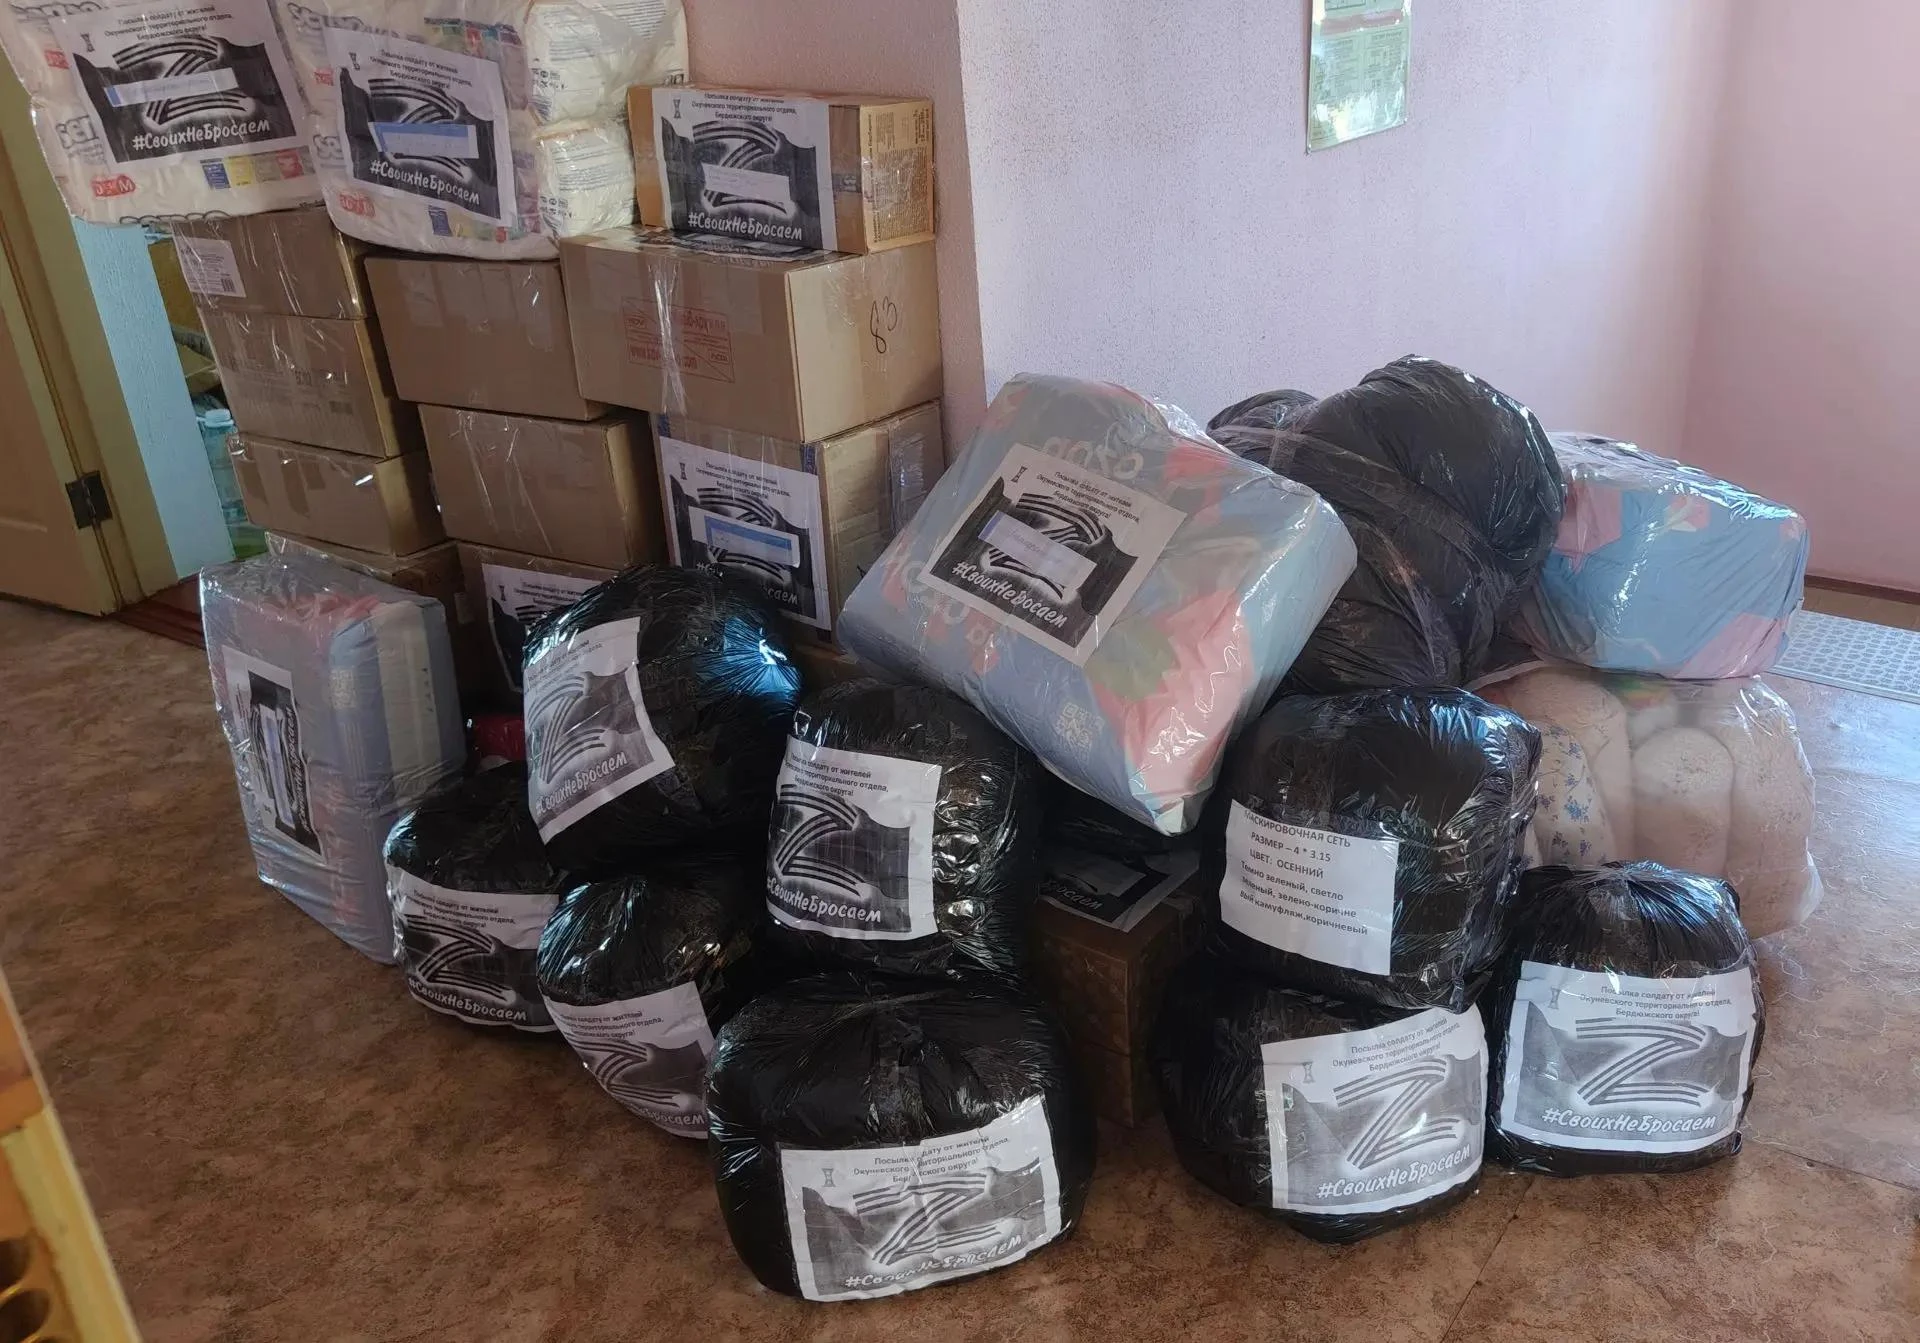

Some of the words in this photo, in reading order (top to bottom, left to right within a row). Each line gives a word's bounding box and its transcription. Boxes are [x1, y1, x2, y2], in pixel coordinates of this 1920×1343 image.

[132, 119, 270, 151] #СвоихНеБросаем
[369, 160, 480, 205] #СвоихНеБросаем
[688, 212, 802, 240] #СвоихНеБросаем
[840, 768, 871, 778] жителей
[860, 782, 889, 793] отдела,
[1251, 832, 1284, 850] РАЗМЕР
[1309, 850, 1331, 862] 3.15
[1326, 834, 1351, 848] СЕТЬ
[1249, 849, 1273, 865] ЦВЕТ:
[1277, 859, 1324, 879] ОСЕННИЙ
[1241, 860, 1264, 879] Темно
[1266, 872, 1308, 894] зеленый,
[1310, 887, 1344, 901] светло
[409, 977, 527, 1021] #СвоихНеБросаем
[1641, 990, 1675, 1001] солдату
[1616, 1009, 1673, 1020] Бердюжского
[1351, 1041, 1386, 1054] Посылка
[1386, 1033, 1416, 1047] солдату
[1417, 1030, 1424, 1038] от
[1332, 1053, 1384, 1068] Окуневского
[1369, 1053, 1419, 1072] Бердюжского
[1541, 1108, 1717, 1136] #СвоихНеБросаем
[1317, 1144, 1471, 1199] #СвоихНеБросаем
